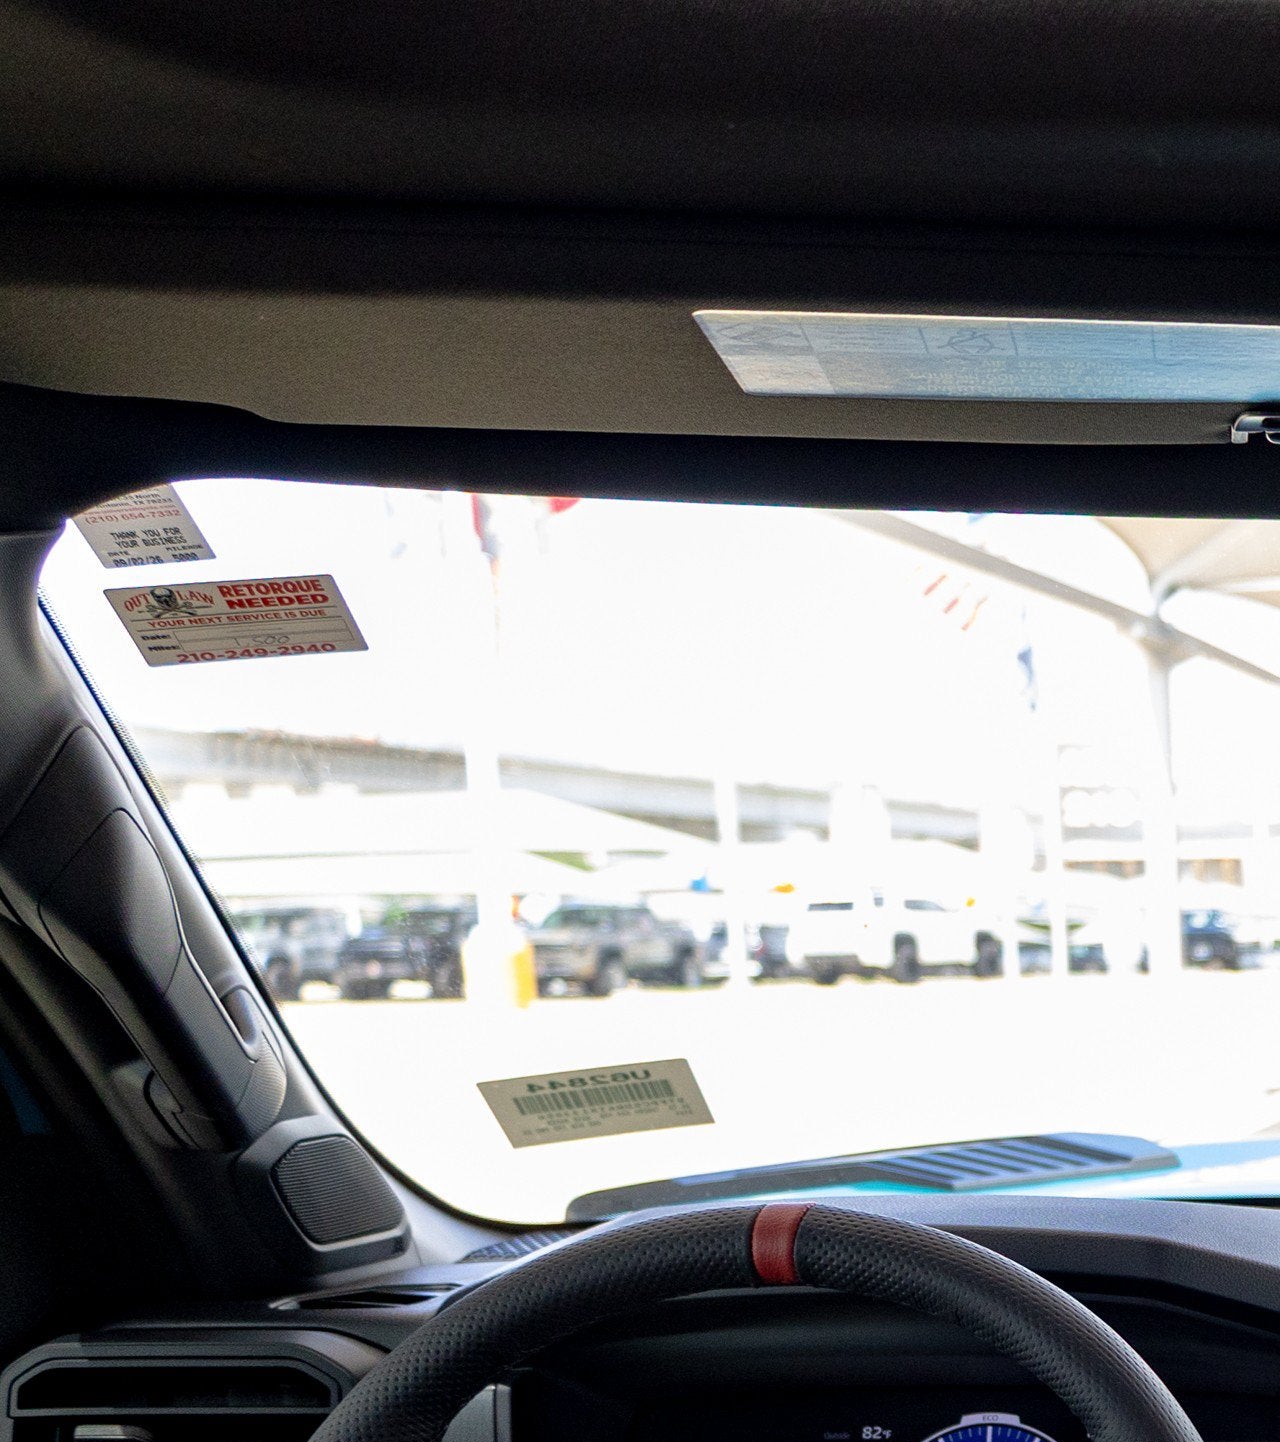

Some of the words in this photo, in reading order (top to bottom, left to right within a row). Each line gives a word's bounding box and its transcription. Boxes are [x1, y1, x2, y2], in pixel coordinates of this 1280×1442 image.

[85, 515, 119, 525] (210)
[121, 508, 182, 521] 654-7332
[110, 530, 140, 541] THANK
[142, 528, 160, 539] YOU
[163, 526, 182, 537] FOR
[115, 539, 141, 549] YOUR
[142, 535, 188, 547] BUSINESS
[176, 588, 216, 607] LAW
[217, 579, 325, 599] RETORQUE
[124, 593, 151, 612] OUT
[224, 593, 330, 610] NEEDED
[147, 619, 186, 630] YOUR
[187, 616, 223, 626] NEXT
[226, 612, 283, 624] SERVICE
[285, 610, 298, 619] IS
[299, 608, 328, 618] DUE
[177, 642, 337, 664] 210-249-2940
